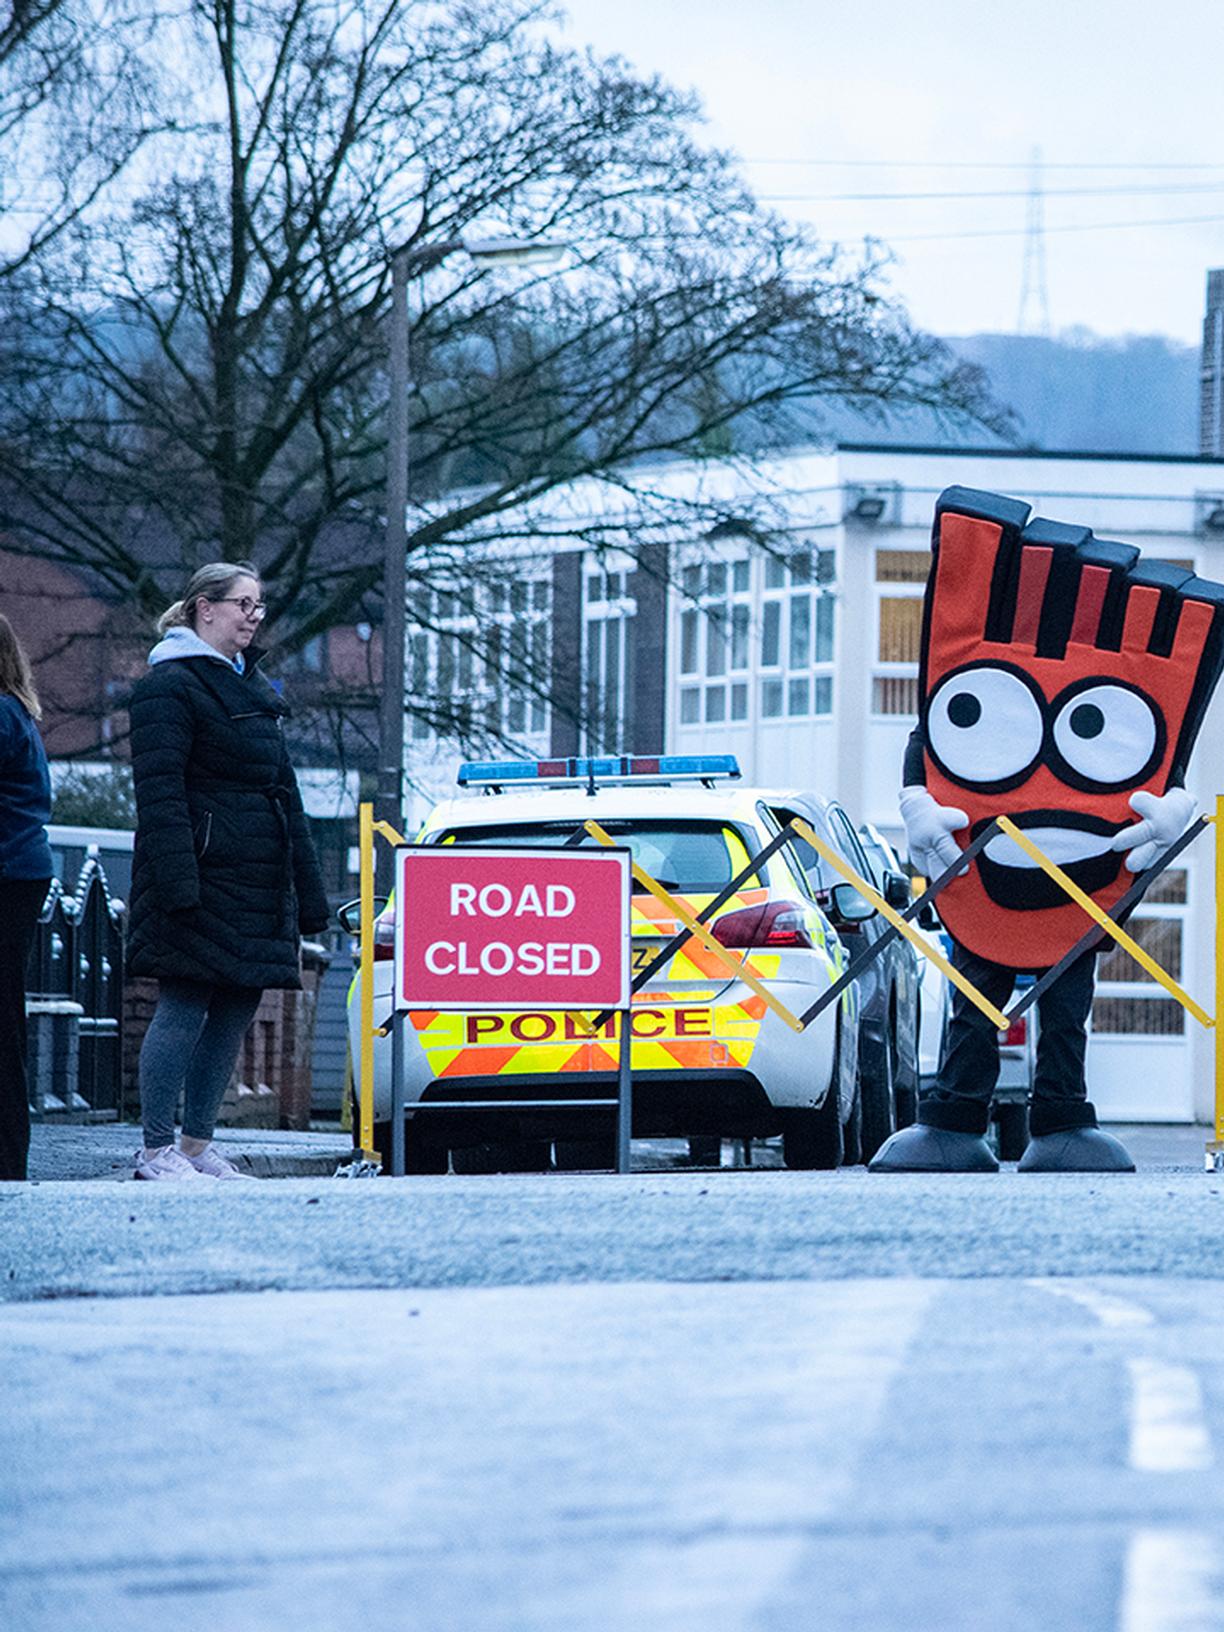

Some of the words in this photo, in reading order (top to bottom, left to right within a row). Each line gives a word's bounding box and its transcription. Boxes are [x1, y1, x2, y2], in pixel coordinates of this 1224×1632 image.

[450, 883, 576, 918] ROAD
[424, 940, 601, 976] CLOSED
[466, 1008, 711, 1043] POLICE
